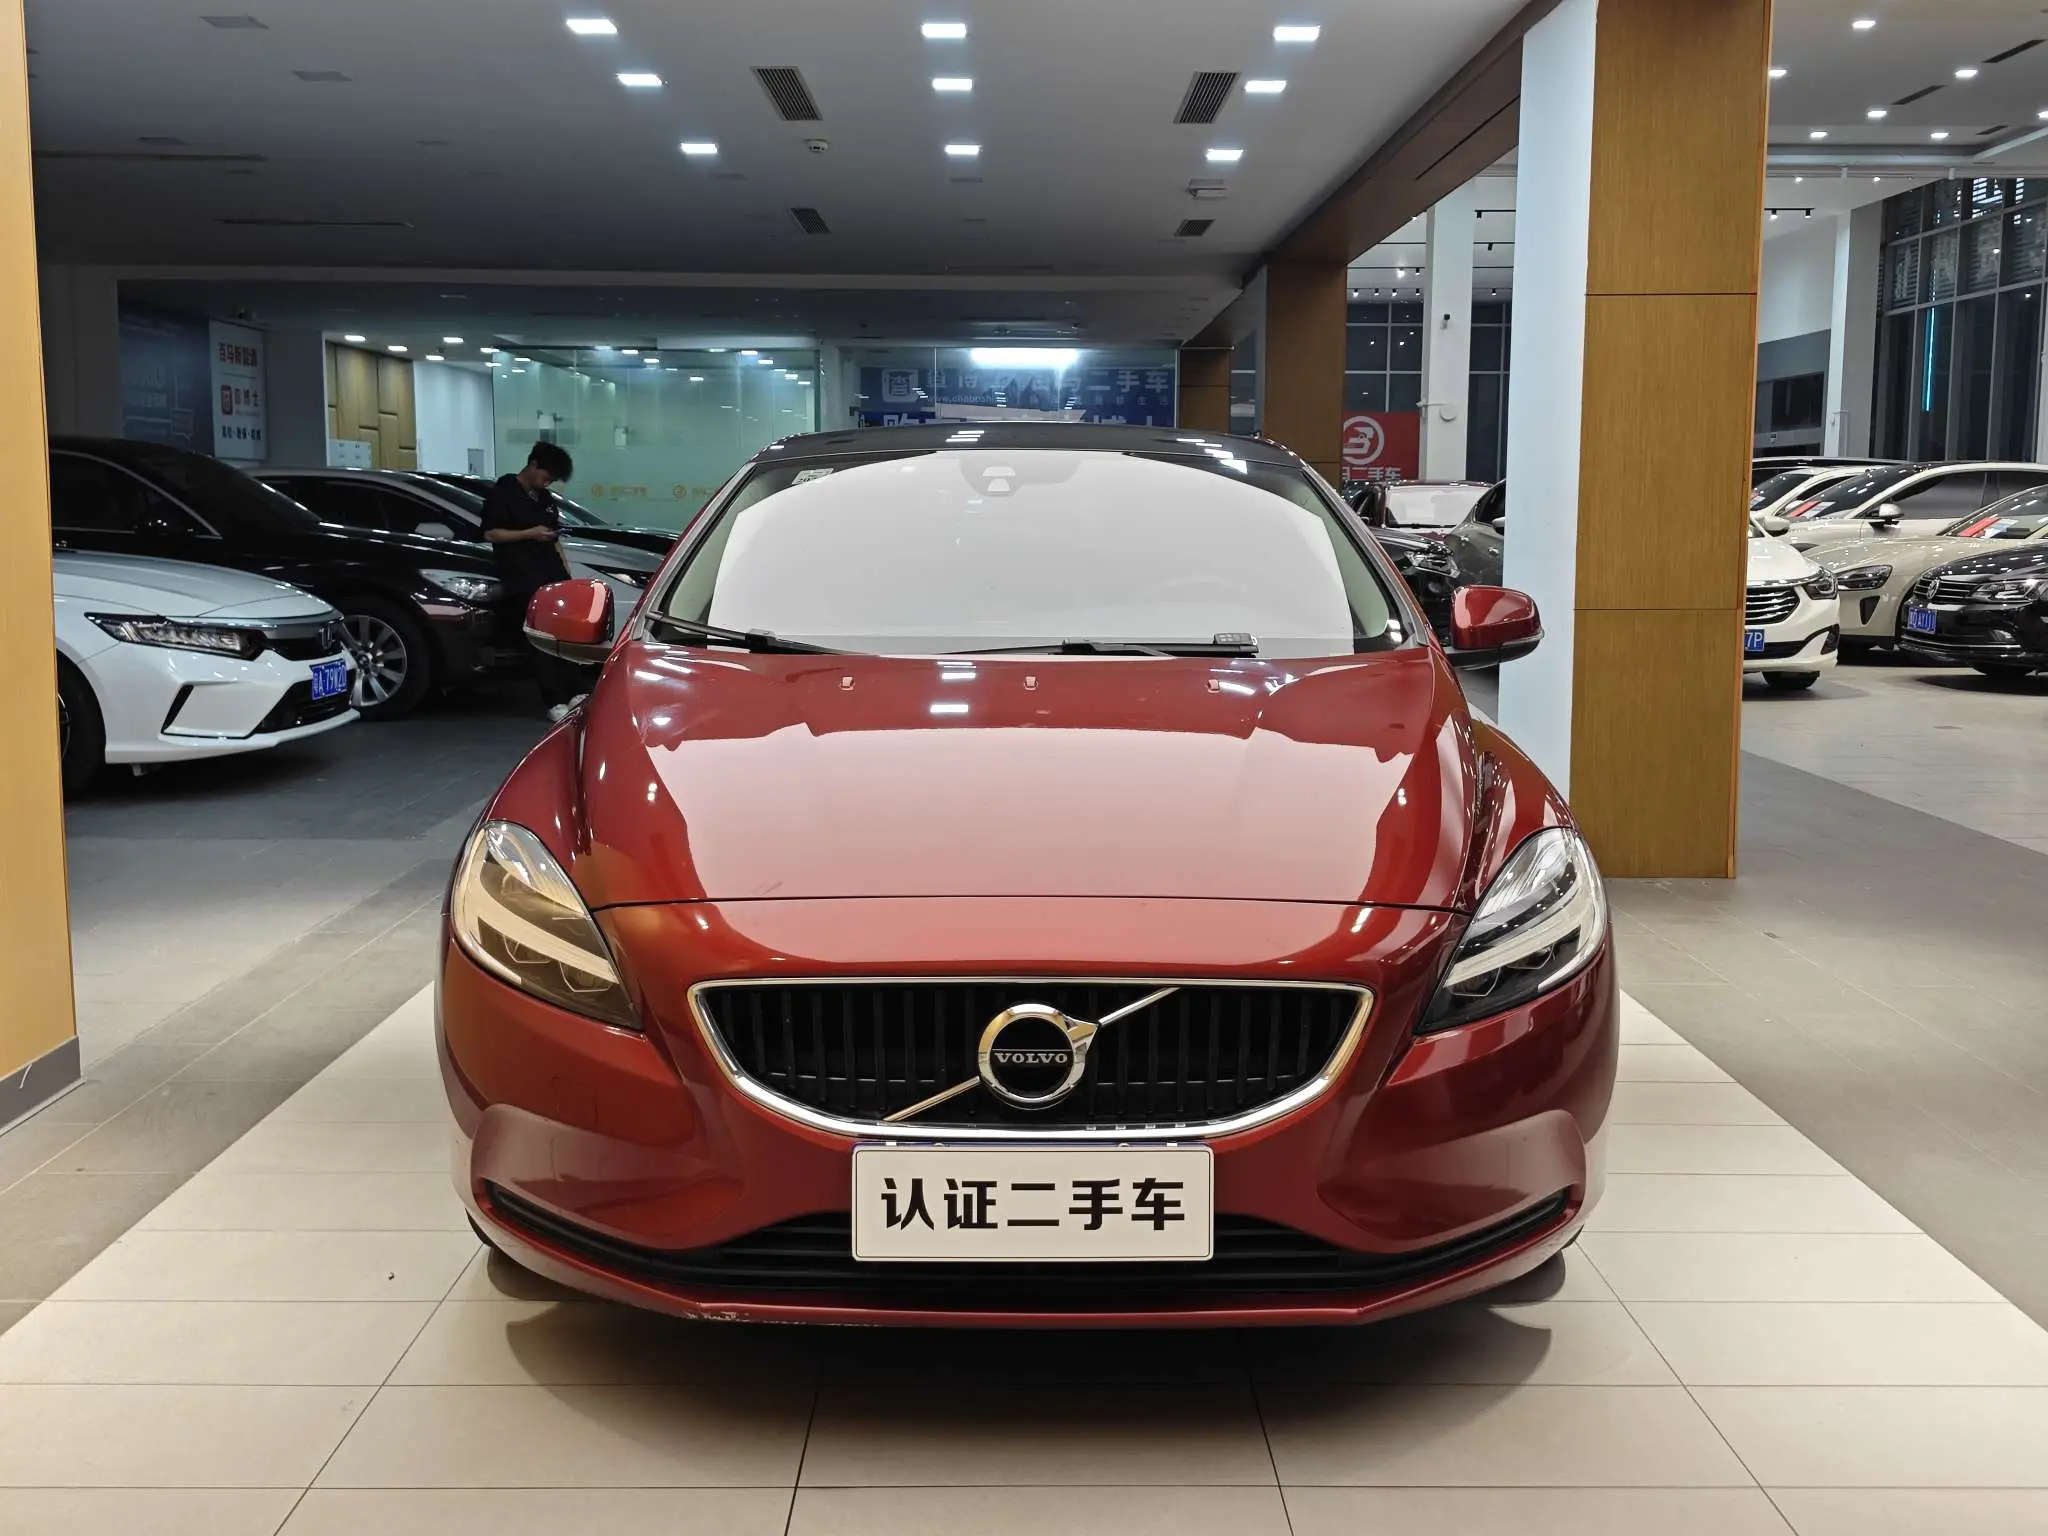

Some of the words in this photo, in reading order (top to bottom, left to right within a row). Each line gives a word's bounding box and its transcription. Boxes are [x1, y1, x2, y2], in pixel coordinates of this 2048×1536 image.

[994, 1052, 1068, 1064] VOLVO
[881, 1177, 1185, 1231] 认证二手车
